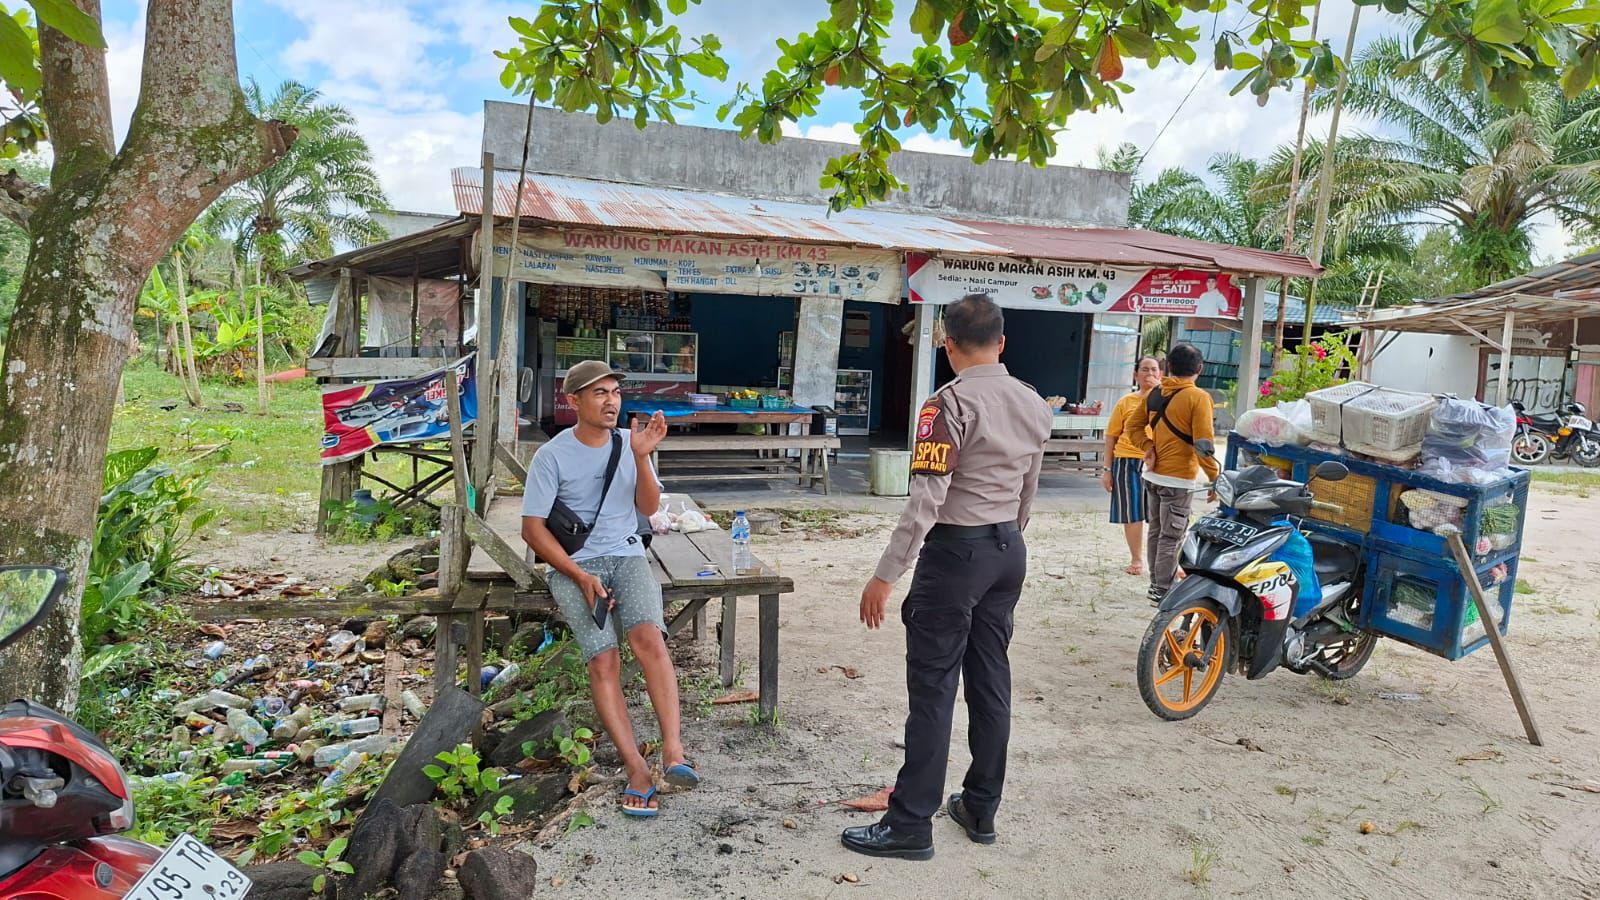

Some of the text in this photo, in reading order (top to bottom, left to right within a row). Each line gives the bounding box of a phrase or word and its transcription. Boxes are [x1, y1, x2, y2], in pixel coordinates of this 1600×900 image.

[564, 233, 828, 262] WARUNG MAKAN ASIH KM 43
[523, 249, 542, 258] NASI
[585, 254, 612, 263] RAWON
[524, 260, 557, 270] LALAPAN
[678, 259, 695, 268] KOPI
[585, 265, 603, 273] NASI
[765, 267, 782, 275] SUSU
[943, 259, 1116, 280] WARUNG MAKAN ASIH KM. 43
[677, 276, 717, 286] TEH HANGAT
[725, 277, 737, 285] DLL
[938, 274, 962, 282] Sedia:
[987, 278, 1018, 287] Campur
[969, 285, 999, 294] Lalapan
[917, 442, 950, 464] SPKT
[176, 840, 215, 871] TR
